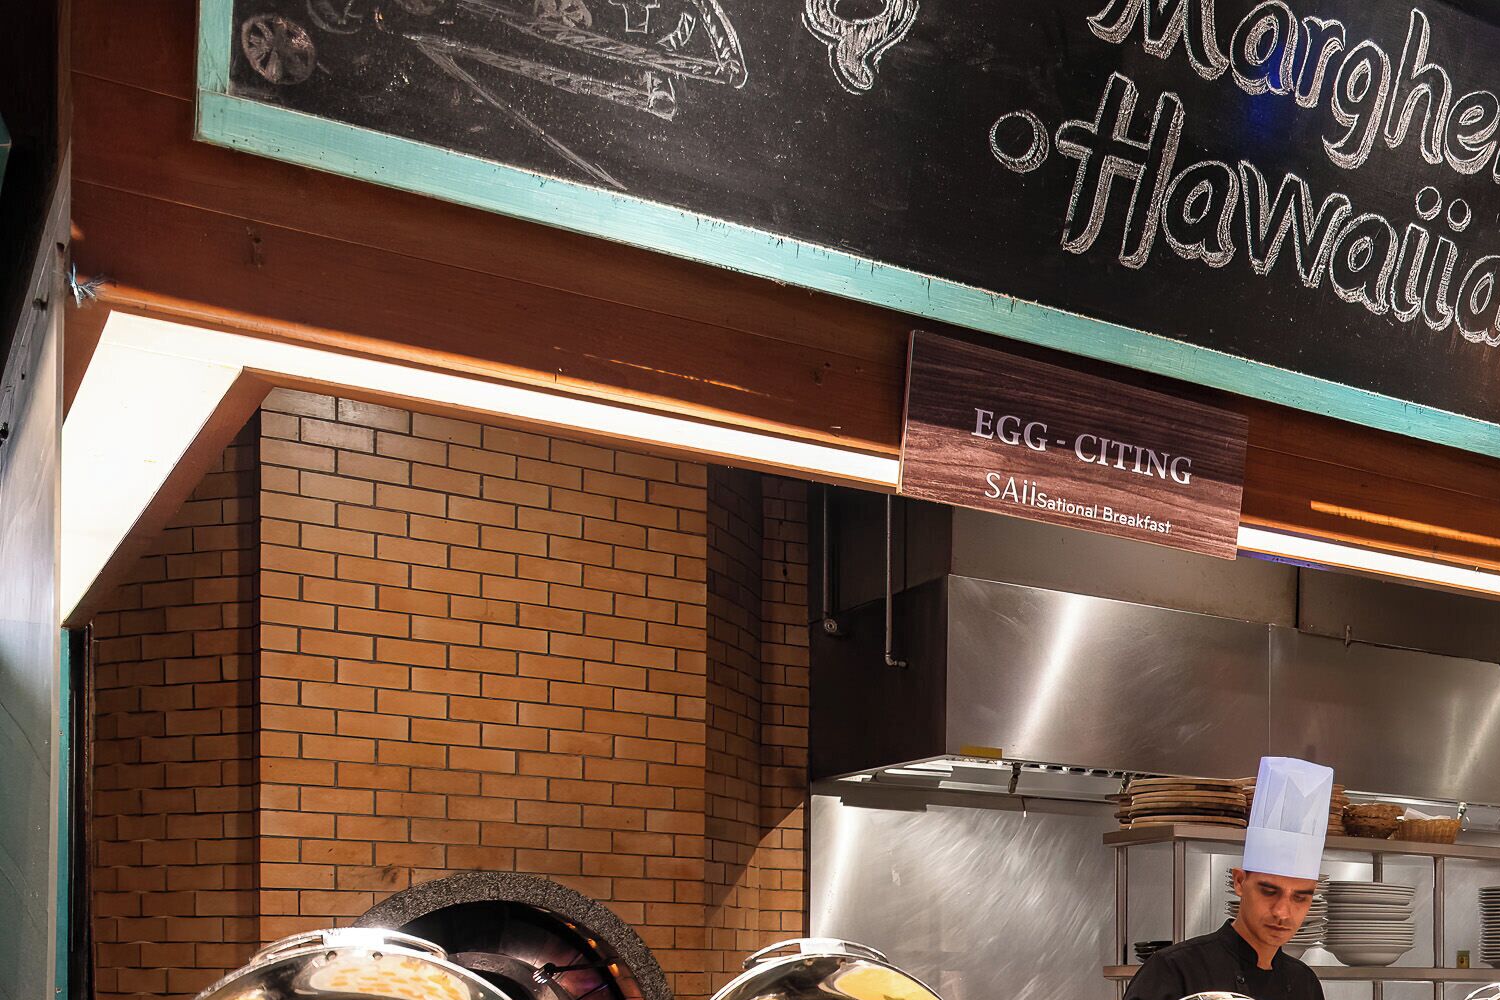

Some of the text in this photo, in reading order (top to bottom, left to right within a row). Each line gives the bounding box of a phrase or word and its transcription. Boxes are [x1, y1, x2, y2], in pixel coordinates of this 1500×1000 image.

[971, 407, 1048, 452] EGG
[1074, 433, 1193, 485] CITING
[1102, 506, 1172, 534] Breakfast
